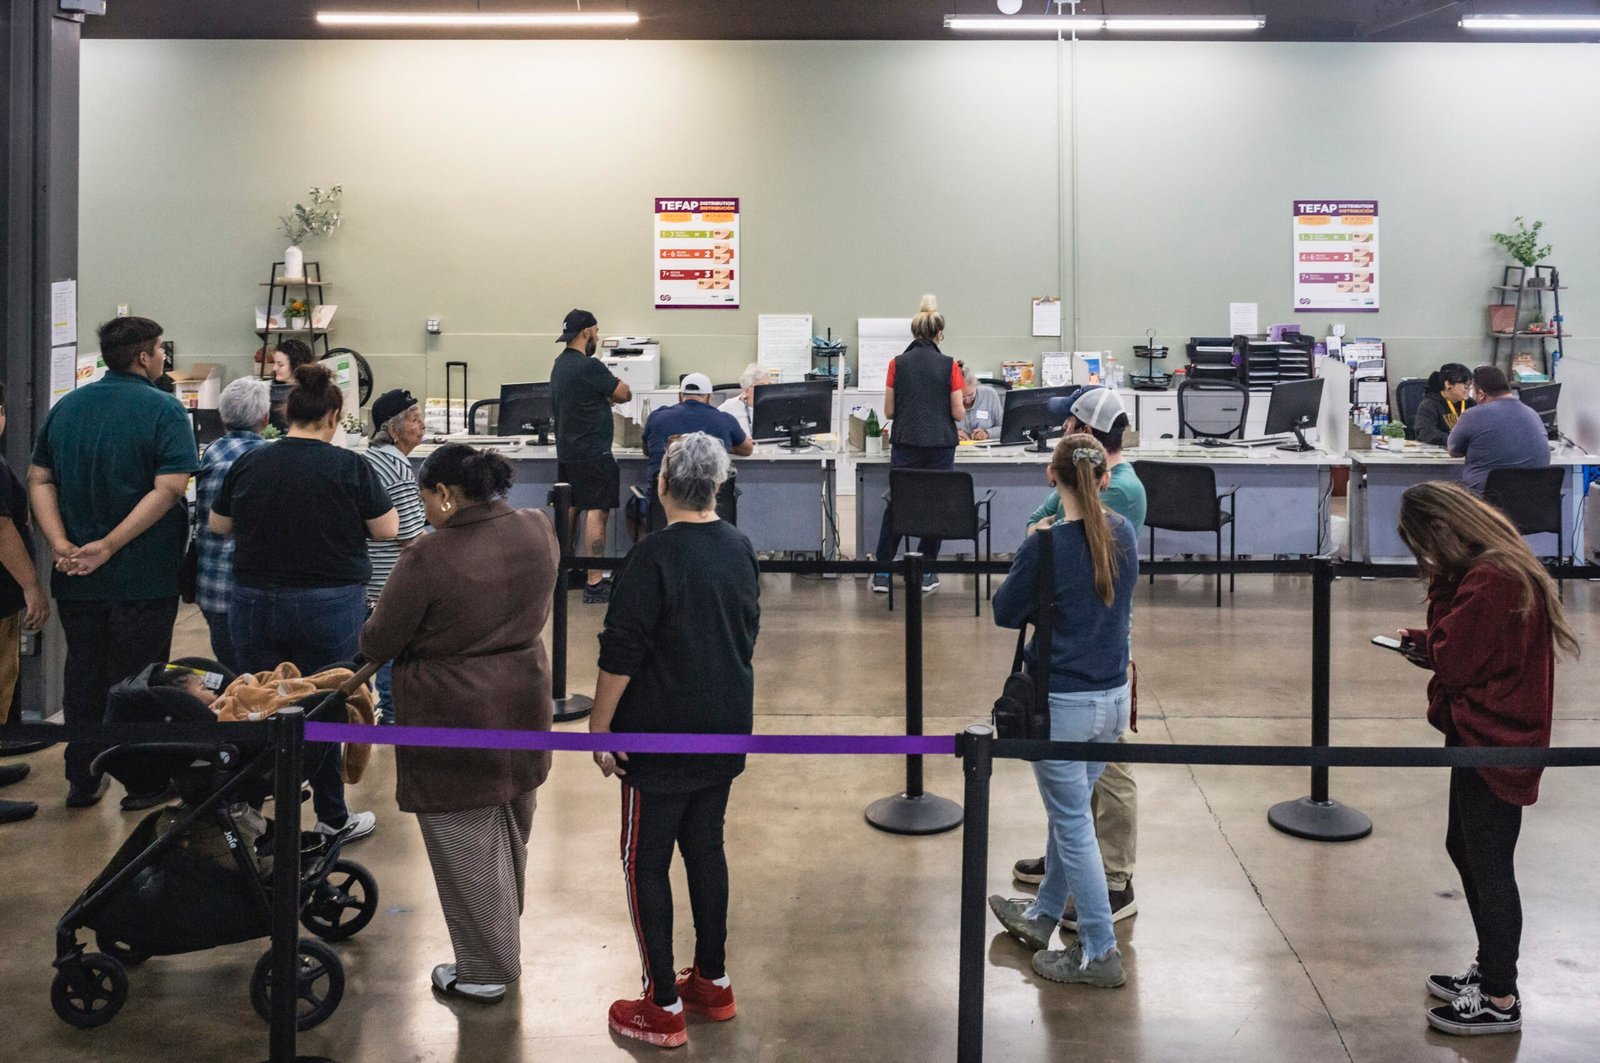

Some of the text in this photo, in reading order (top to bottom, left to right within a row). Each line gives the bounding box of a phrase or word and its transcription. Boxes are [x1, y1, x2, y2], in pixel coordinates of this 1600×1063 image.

[660, 201, 698, 210] TEFAP
[1298, 204, 1338, 213] TEFAP
[223, 831, 238, 849] Joie
